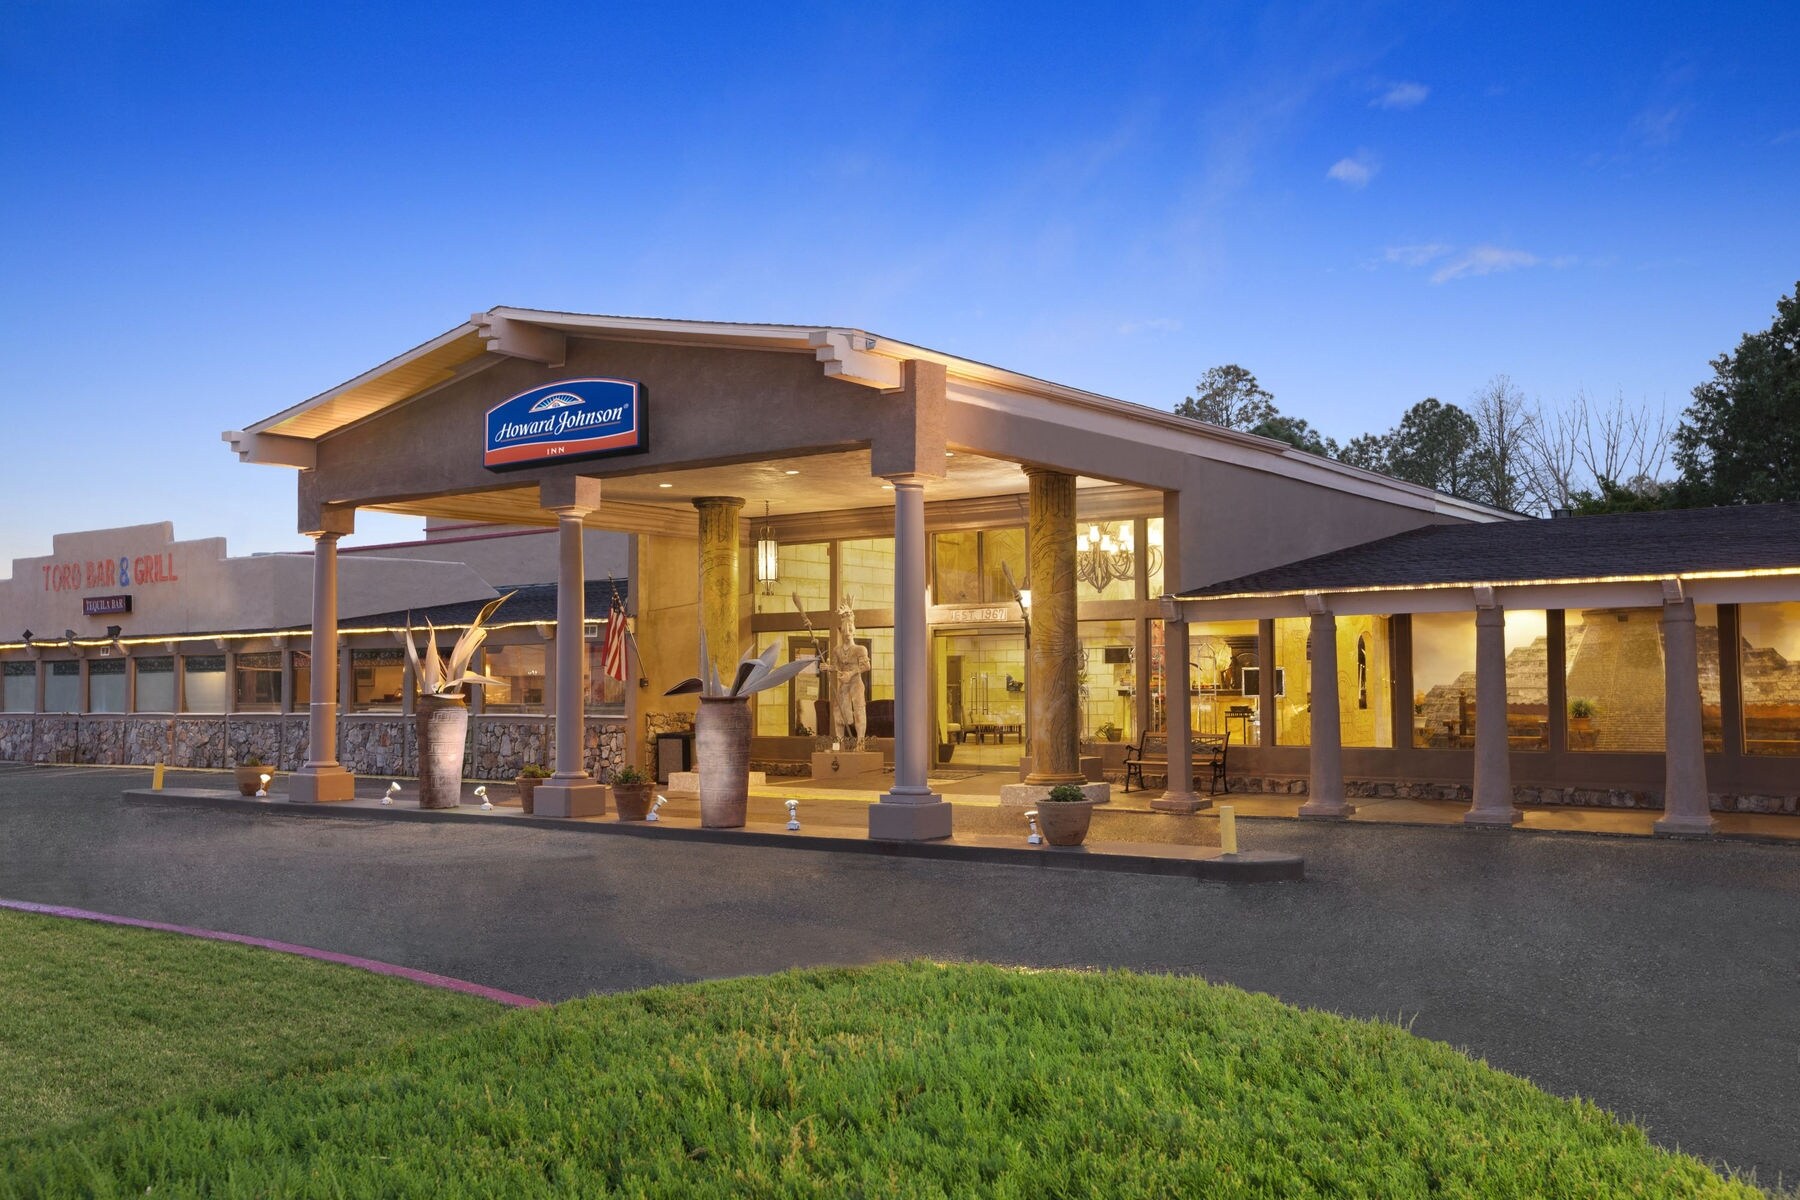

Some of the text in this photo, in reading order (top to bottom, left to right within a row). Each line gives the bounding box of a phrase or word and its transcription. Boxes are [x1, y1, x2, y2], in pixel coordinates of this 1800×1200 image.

[495, 407, 622, 442] Howard Johnson
[546, 446, 565, 456] INN
[42, 552, 178, 593] TORO BAR & GRILL
[86, 598, 124, 612] TEQUILA BAR
[981, 608, 1004, 620] 1967
